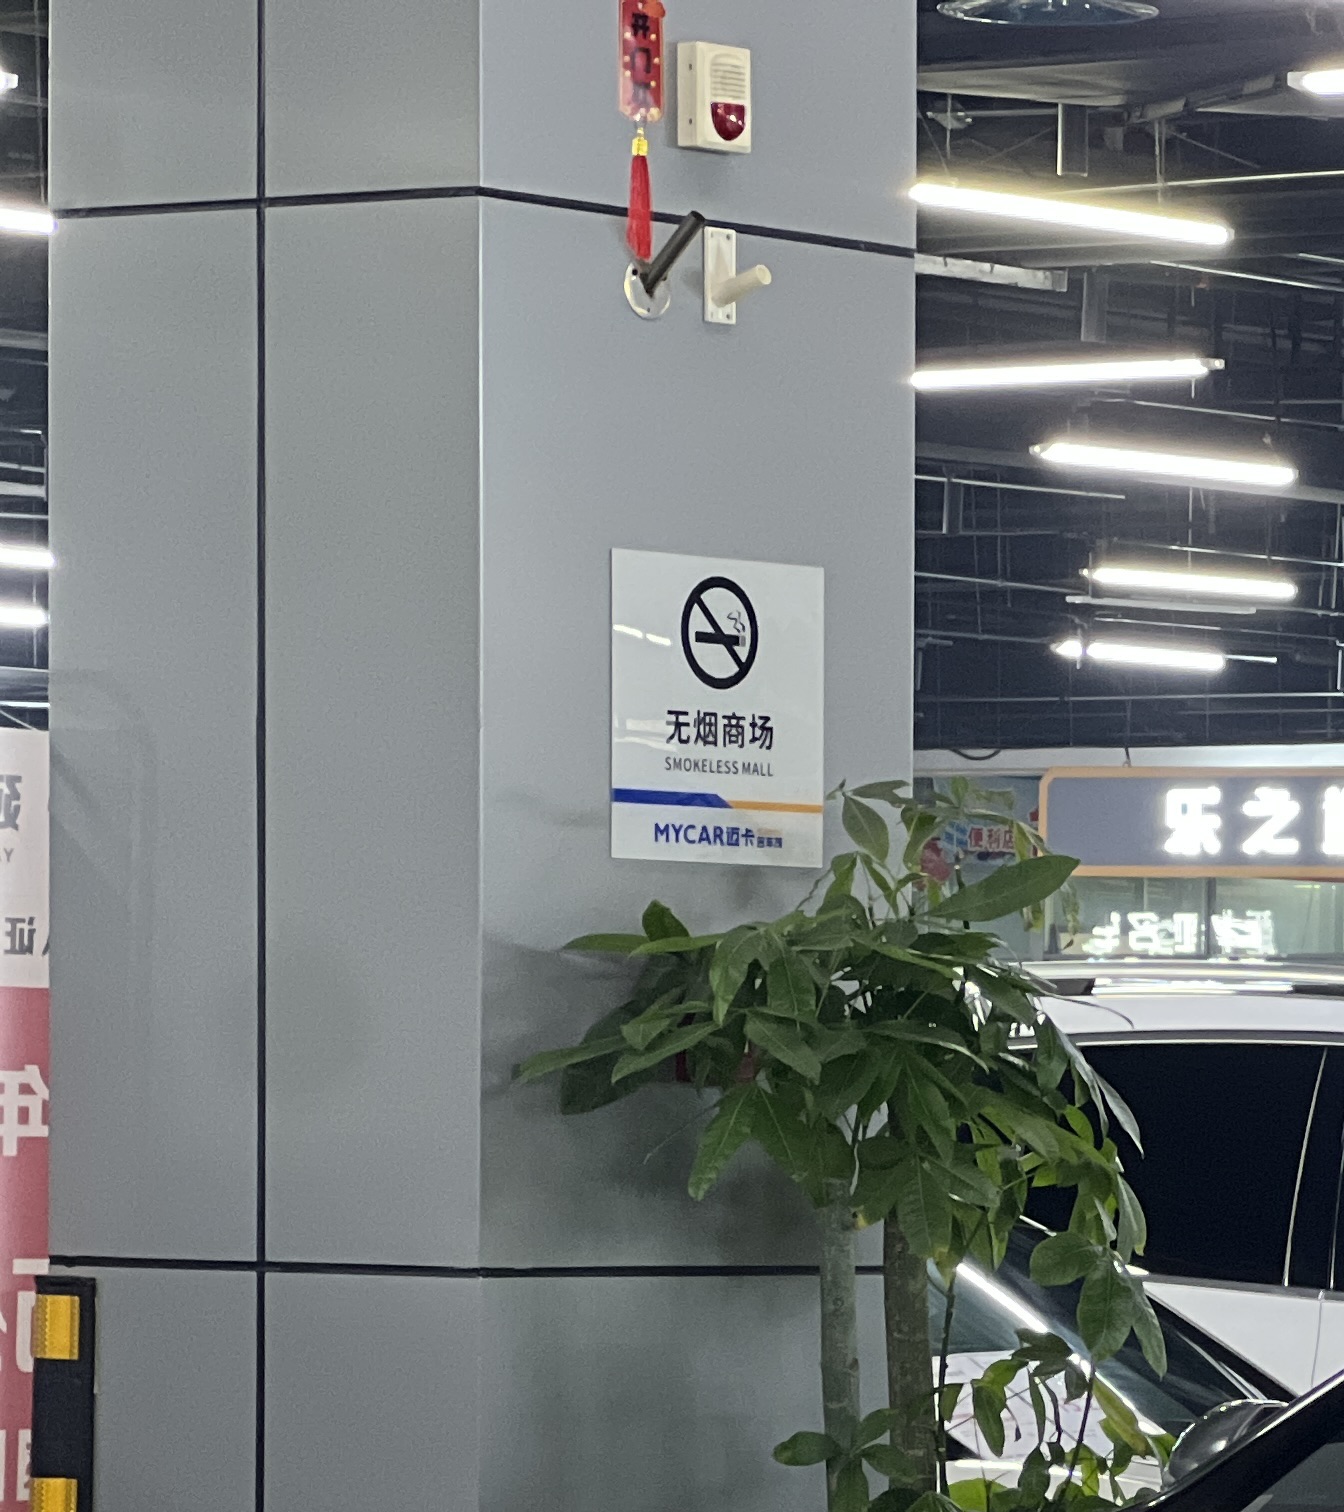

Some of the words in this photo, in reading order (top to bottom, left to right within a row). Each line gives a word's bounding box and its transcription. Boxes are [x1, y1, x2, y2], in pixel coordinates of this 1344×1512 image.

[666, 709, 774, 751] 无烟商场
[664, 756, 739, 775] SMOKELESS
[741, 762, 774, 777] MALL
